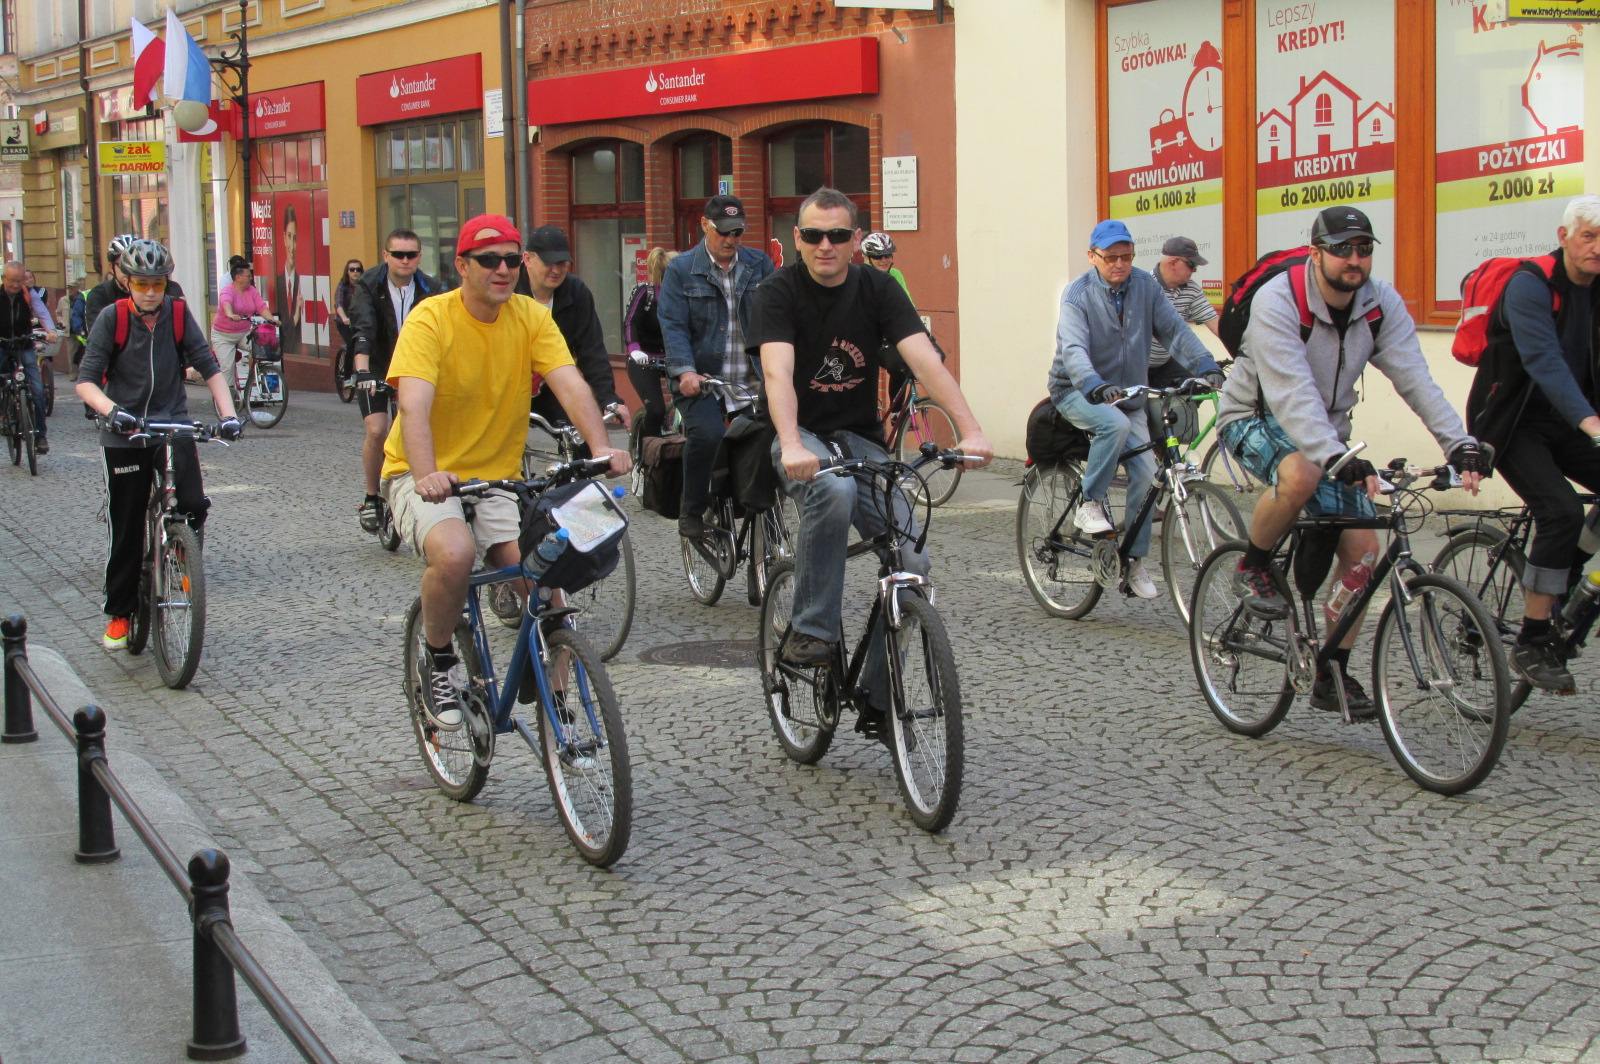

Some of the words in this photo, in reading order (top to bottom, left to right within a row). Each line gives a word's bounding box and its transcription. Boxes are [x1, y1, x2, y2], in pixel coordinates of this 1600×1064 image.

[1268, 2, 1316, 30] Lepszy
[1114, 31, 1150, 52] Szybka
[1277, 20, 1345, 53] KREDYT!
[1121, 43, 1187, 72] GOTÓWKA!
[400, 72, 436, 96] Santander
[660, 67, 706, 90] Santander
[264, 96, 291, 116] Santander
[127, 143, 151, 155] żak
[1478, 139, 1566, 171] POŻYCZKI
[119, 162, 165, 172] DARMO!
[1128, 161, 1204, 190] CHWILÓWKI
[1294, 152, 1358, 178] KREDYTY
[1281, 188, 1298, 207] do
[1302, 180, 1354, 205] 200.000
[1358, 177, 1372, 197] zł
[1488, 178, 1534, 201] 2.000
[1538, 172, 1555, 194] zł
[251, 200, 272, 223] Wejdź
[1136, 196, 1150, 212] do
[1154, 191, 1183, 210] 1.000
[1185, 188, 1197, 204] zł
[1489, 232, 1498, 241] 24
